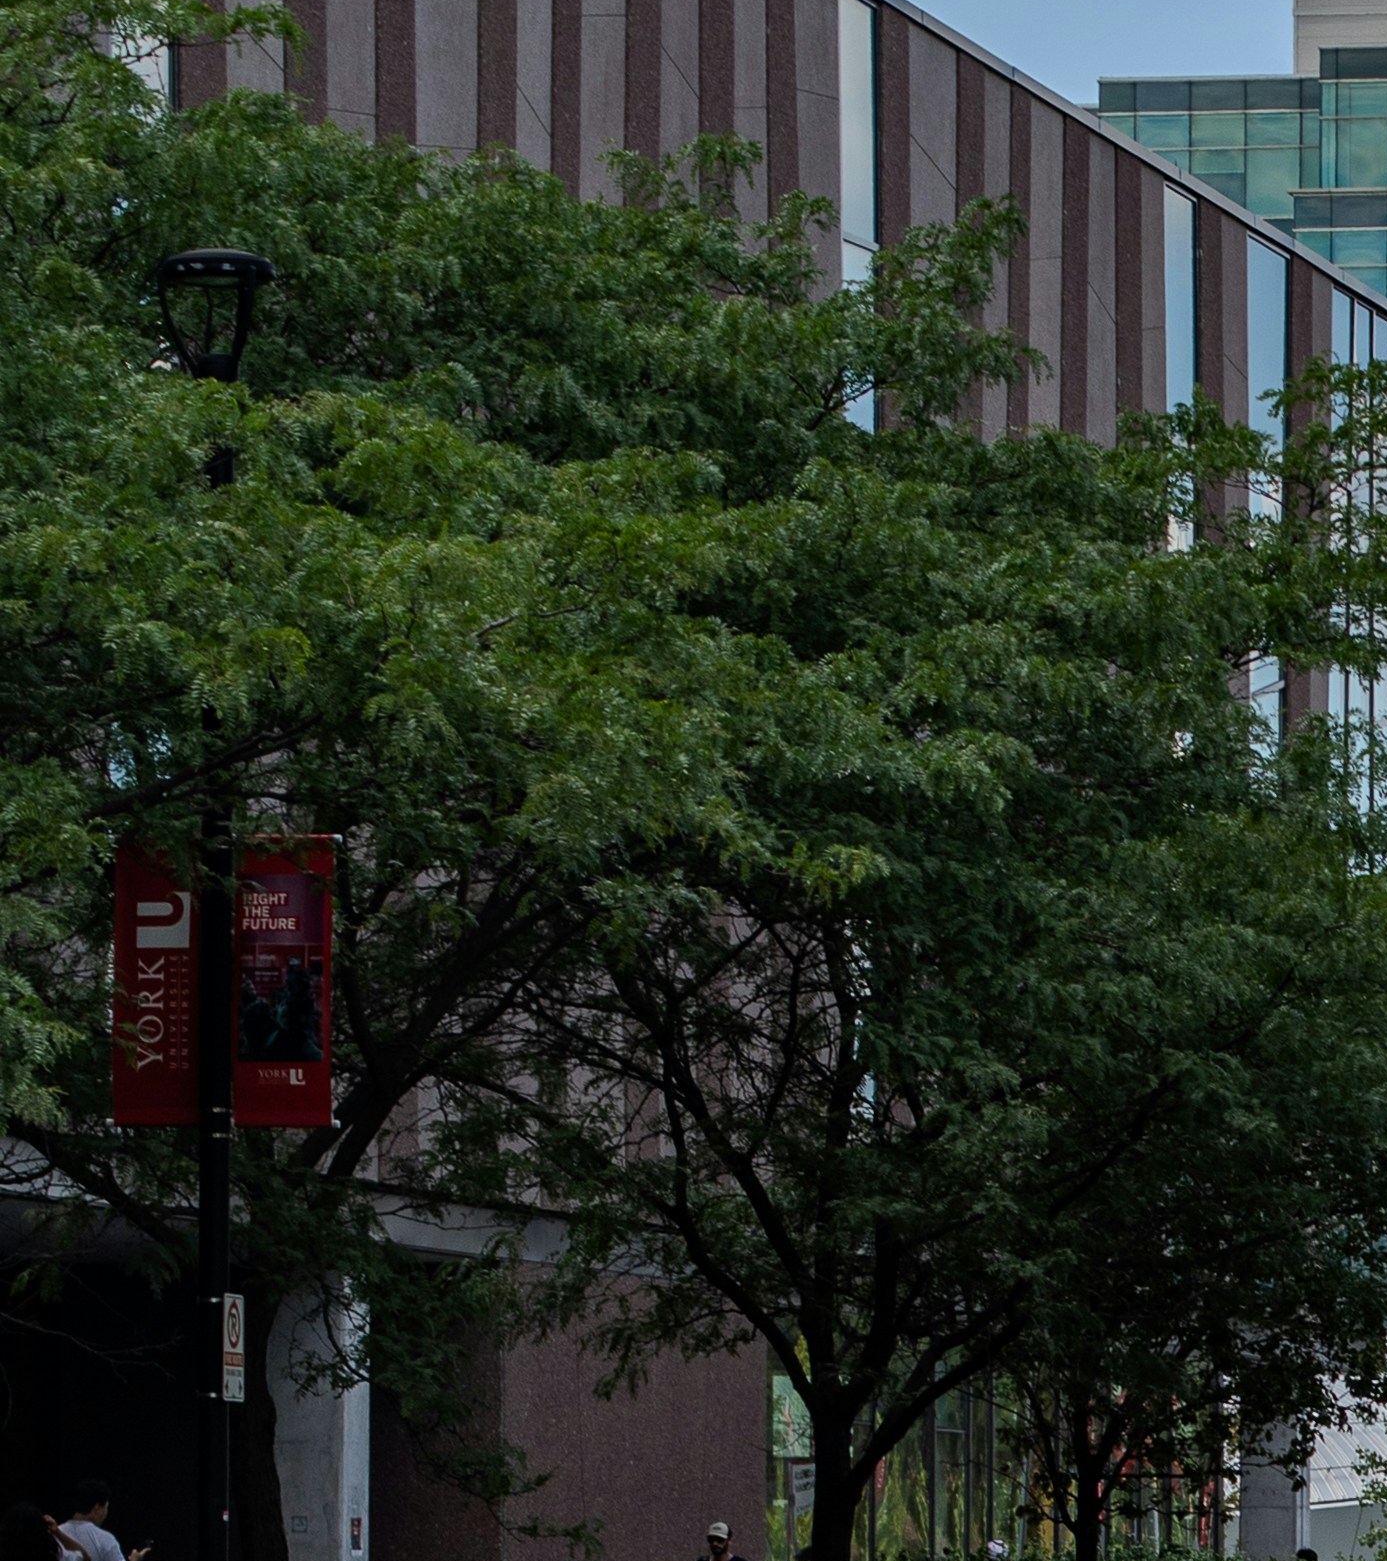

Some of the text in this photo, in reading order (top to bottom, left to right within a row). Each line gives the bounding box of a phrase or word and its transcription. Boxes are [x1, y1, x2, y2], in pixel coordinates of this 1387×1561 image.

[243, 906, 270, 918] THE
[242, 918, 297, 930] FUTURE
[136, 955, 165, 1072] YORK
[181, 954, 190, 1070] UNIVERSITY
[258, 1069, 288, 1079] YORK
